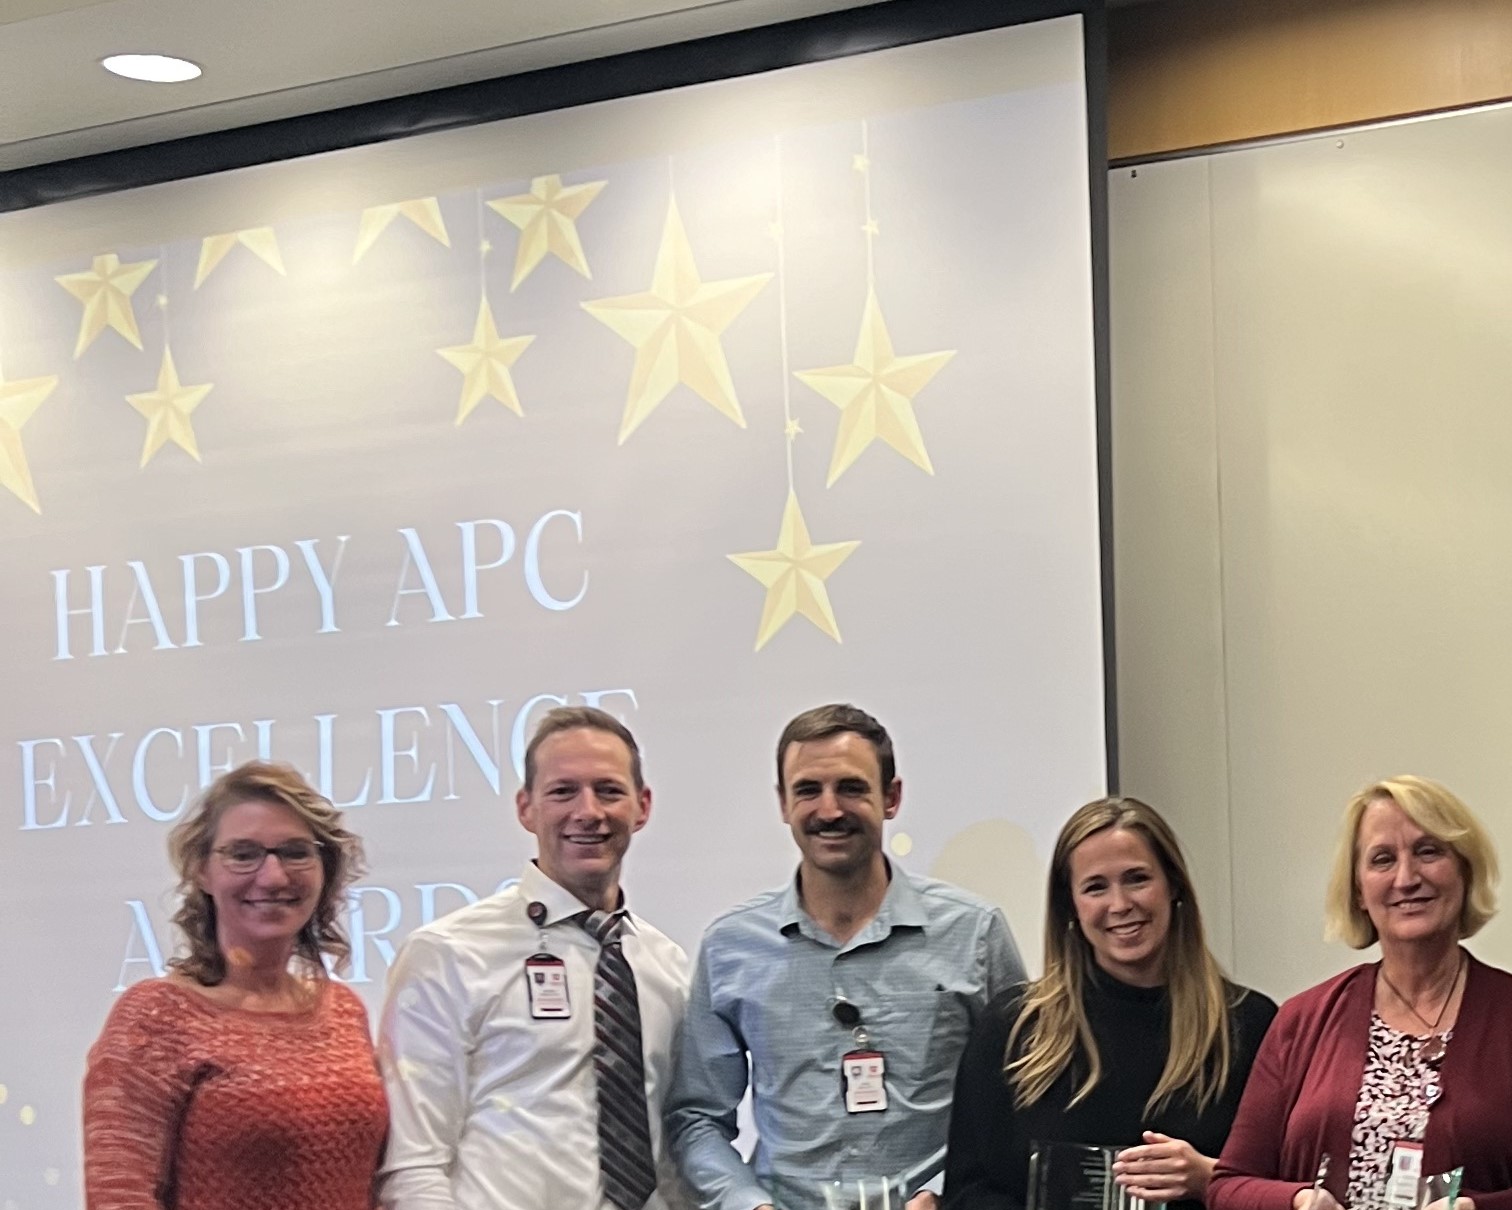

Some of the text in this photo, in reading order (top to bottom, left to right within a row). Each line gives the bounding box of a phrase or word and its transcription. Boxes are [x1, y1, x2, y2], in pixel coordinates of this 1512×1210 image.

[50, 508, 590, 661] HAPPY APC
[17, 687, 642, 831] EXCELENC
